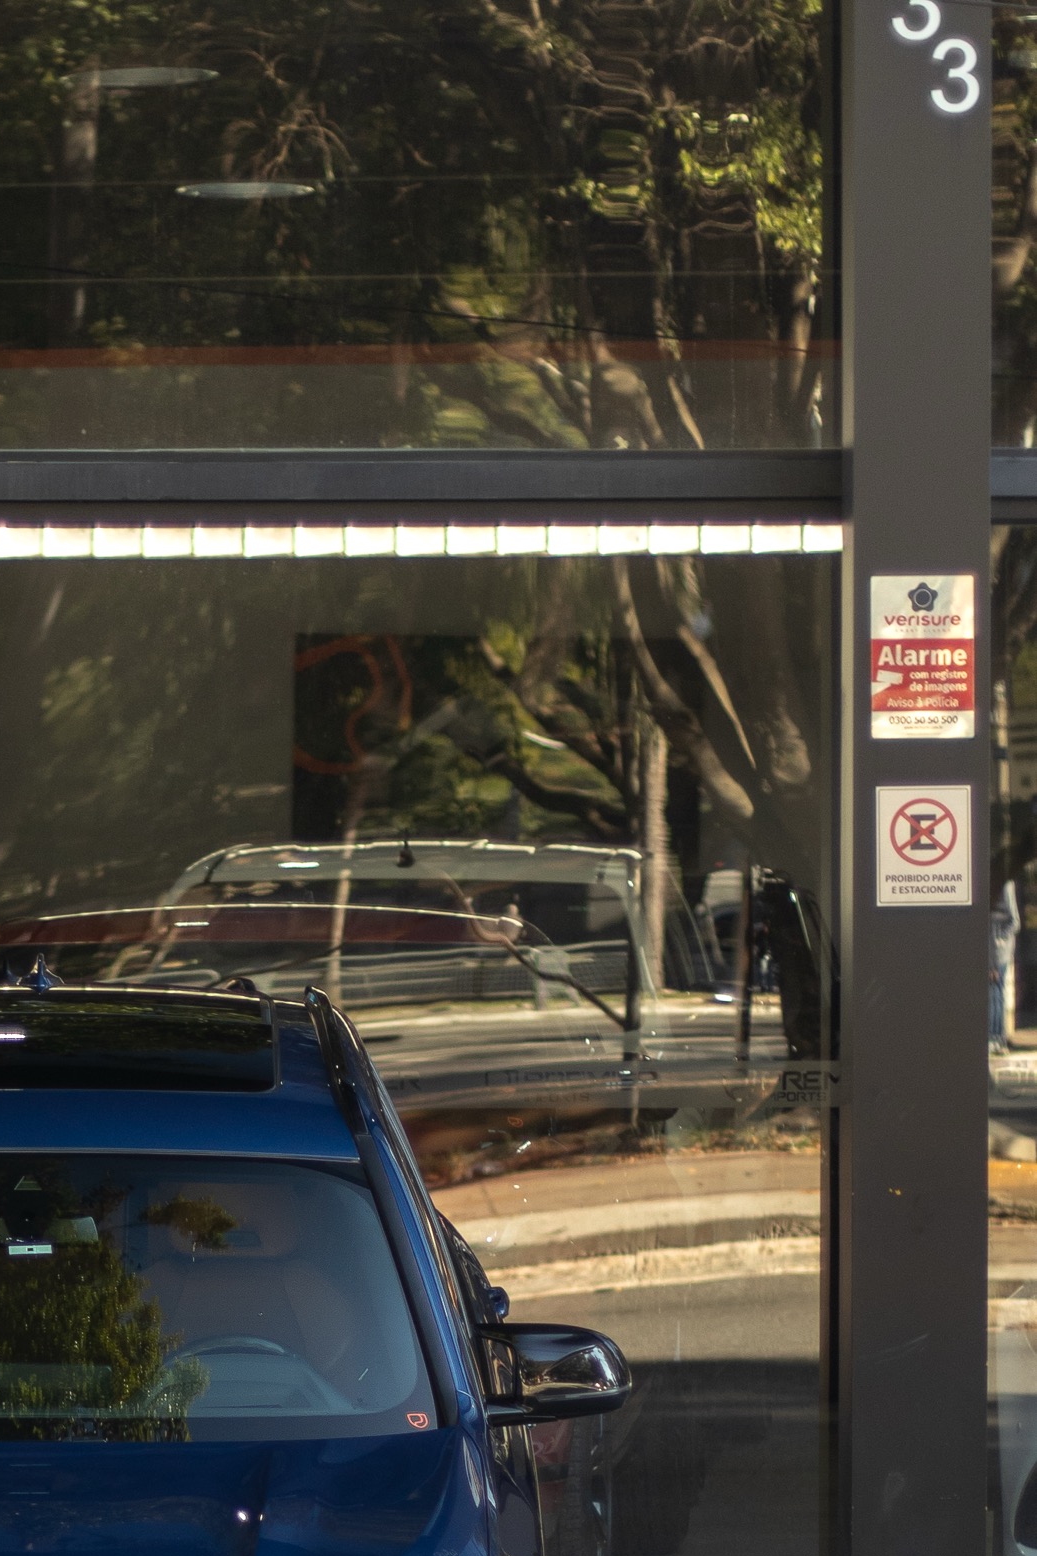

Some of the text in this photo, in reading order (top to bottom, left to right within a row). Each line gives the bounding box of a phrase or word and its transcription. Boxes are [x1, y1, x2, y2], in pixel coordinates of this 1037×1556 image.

[884, 614, 961, 626] verisure
[878, 644, 968, 666] Alarme
[909, 668, 968, 681] com registro
[909, 680, 968, 693] de imagens
[887, 697, 914, 708] Aviso
[888, 715, 912, 725] 0300
[941, 715, 959, 724] 500
[885, 873, 963, 883] PROIBIDO PARAR
[891, 885, 956, 894] E ESTACIONAR
